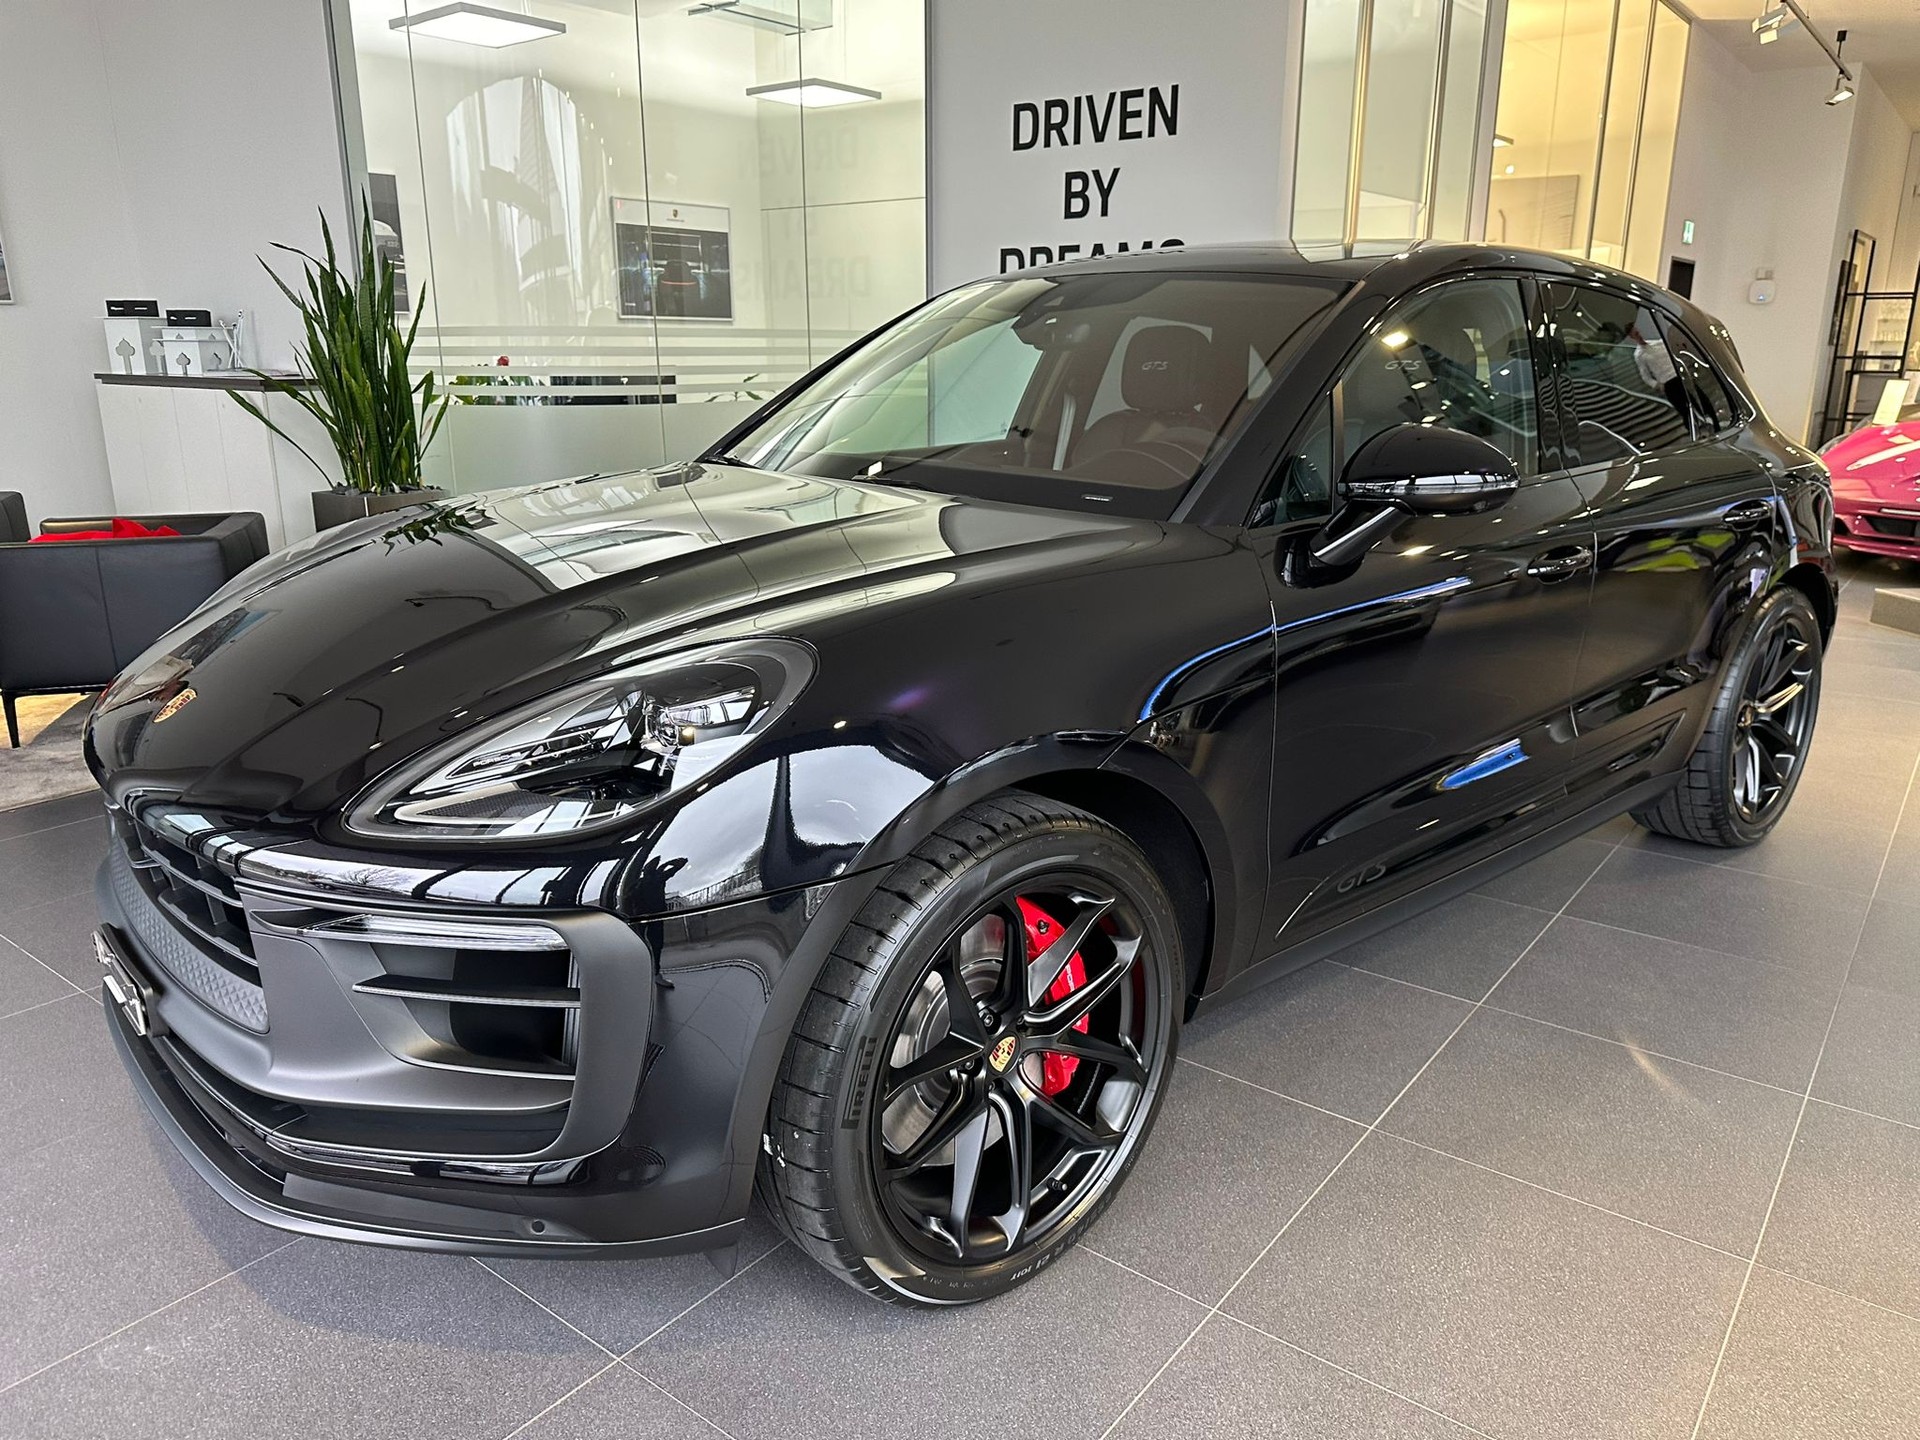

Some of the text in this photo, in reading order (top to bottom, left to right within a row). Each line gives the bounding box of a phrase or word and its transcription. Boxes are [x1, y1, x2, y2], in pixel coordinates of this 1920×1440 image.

[1012, 84, 1179, 151] DRIVEN
[1064, 167, 1120, 219] BY
[1142, 361, 1168, 370] GTS
[1385, 360, 1421, 370] GTS
[1337, 864, 1386, 893] GTS
[841, 1035, 879, 1130] PIRELLI
[1035, 1253, 1051, 1269] 21
